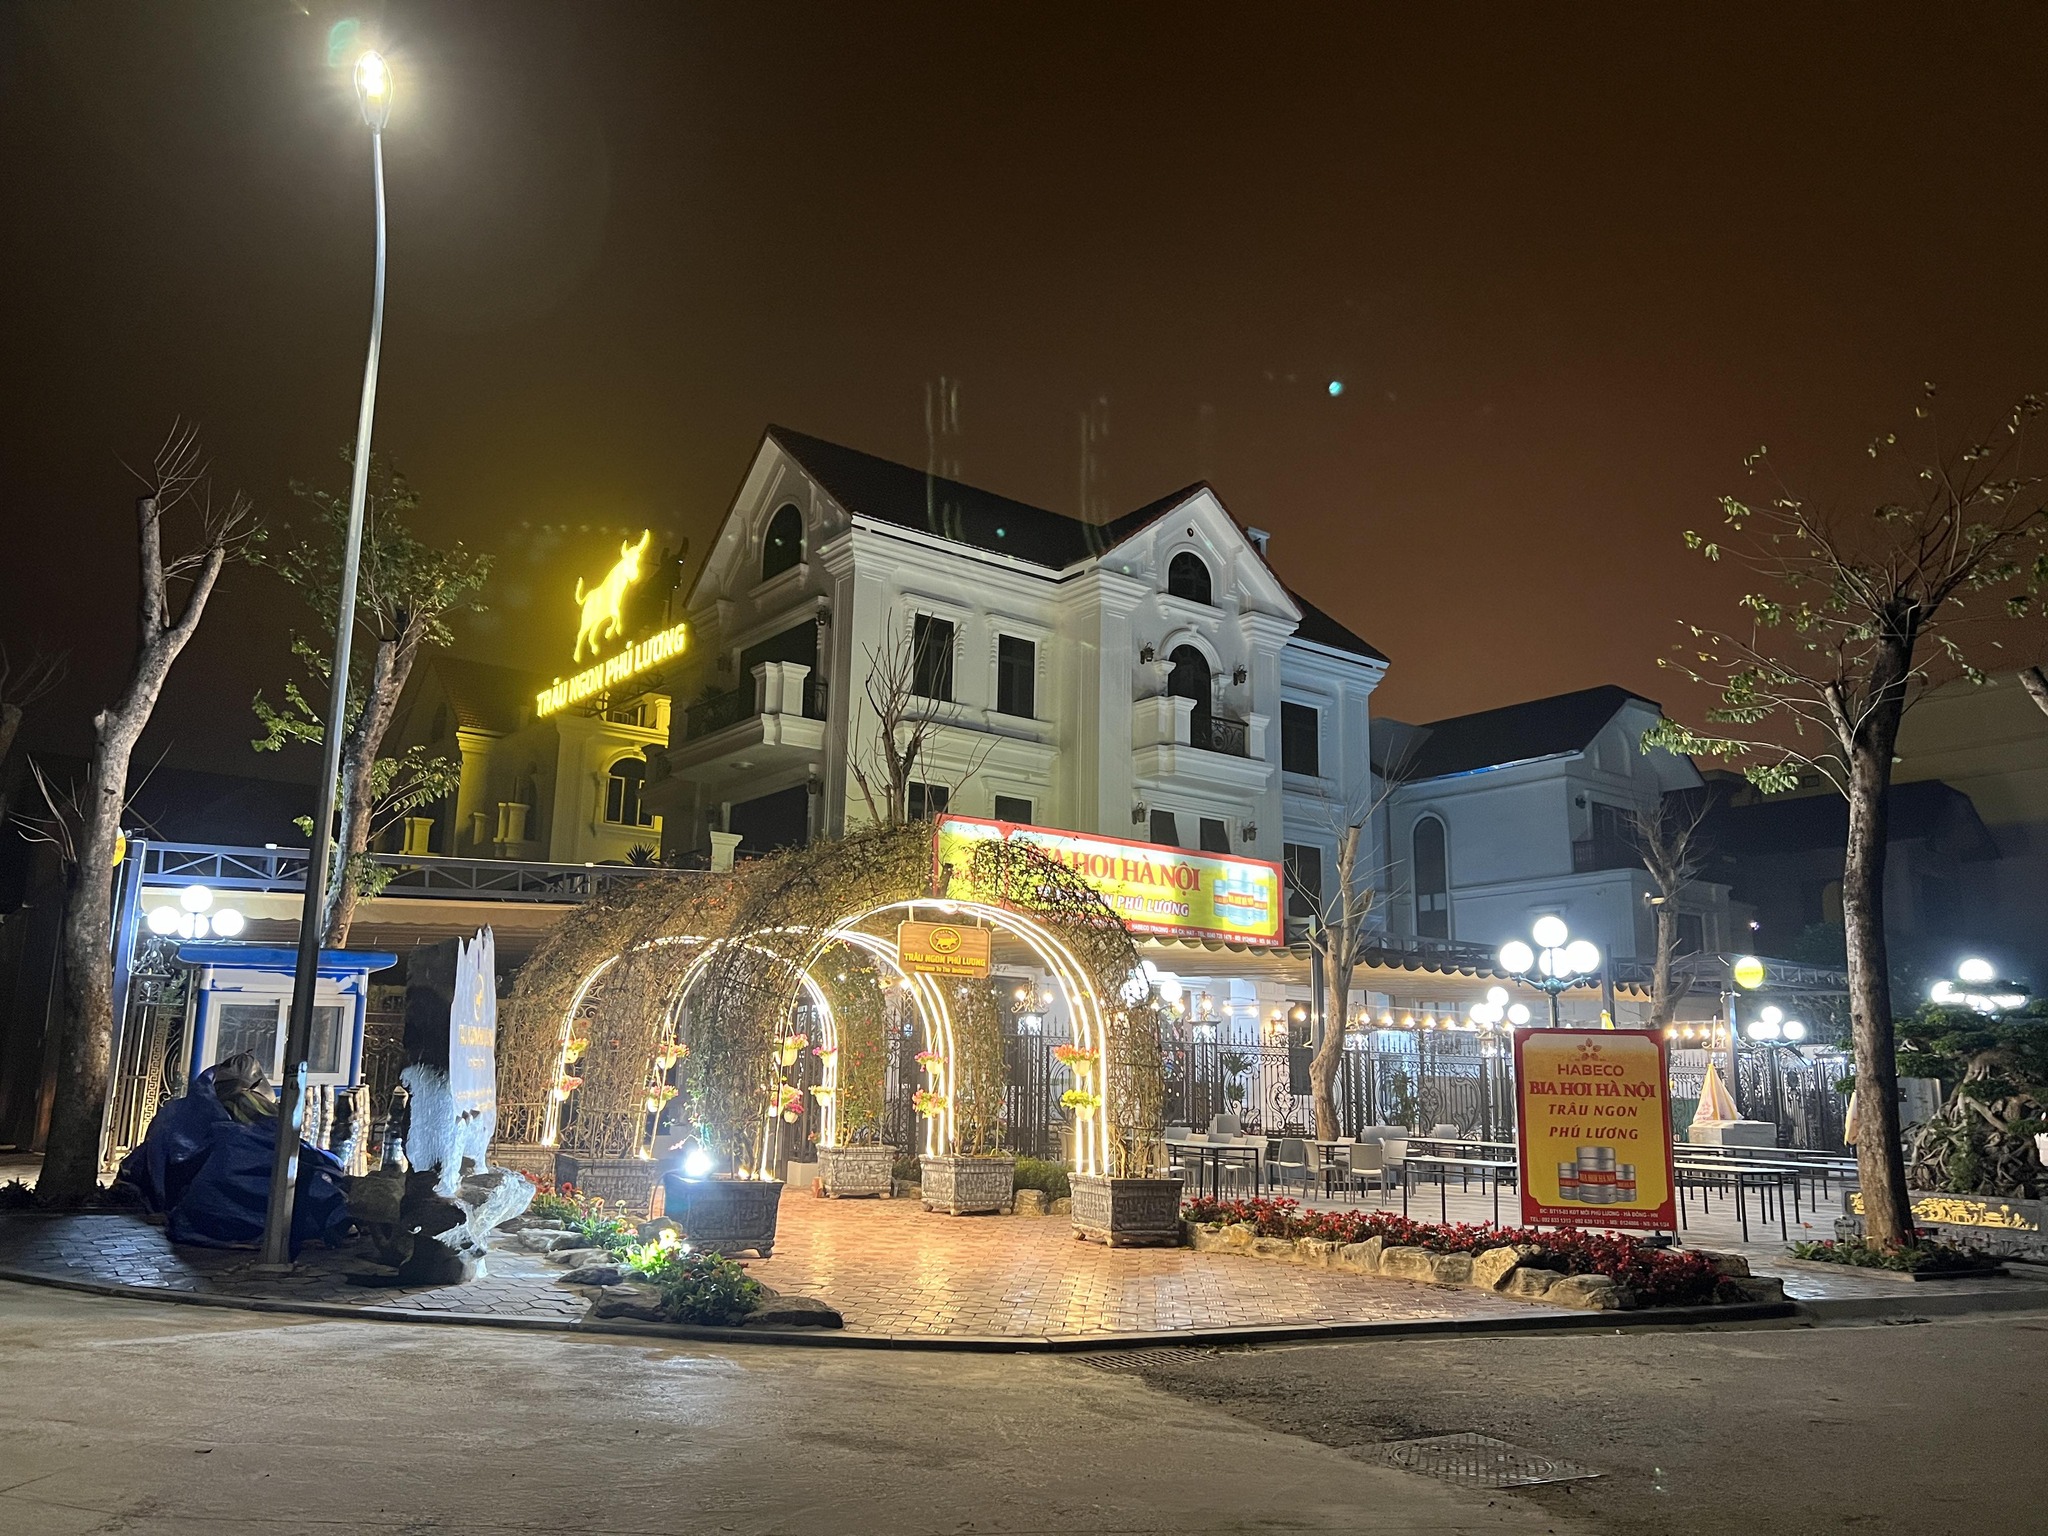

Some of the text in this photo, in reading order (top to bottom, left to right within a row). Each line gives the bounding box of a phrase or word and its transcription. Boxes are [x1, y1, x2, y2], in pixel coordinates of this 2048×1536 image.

[536, 623, 686, 718] TRÂU NGON PHÚ LƯƠNG
[1073, 851, 1119, 879] HƠI
[1121, 855, 1157, 885] HÀ
[1160, 861, 1200, 896] NỘI
[1117, 894, 1144, 911] PHÚ
[1147, 898, 1189, 917] LƯƠNG
[904, 952, 986, 967] TRÂU NGON PHÚ LƯƠNG
[1558, 1064, 1624, 1077] HABECO
[1529, 1080, 1656, 1101] BIA HƠI HÀ NỘI
[1549, 1102, 1638, 1117] TRÂU NGON
[1549, 1124, 1639, 1140] PHÚ LƯƠNG
